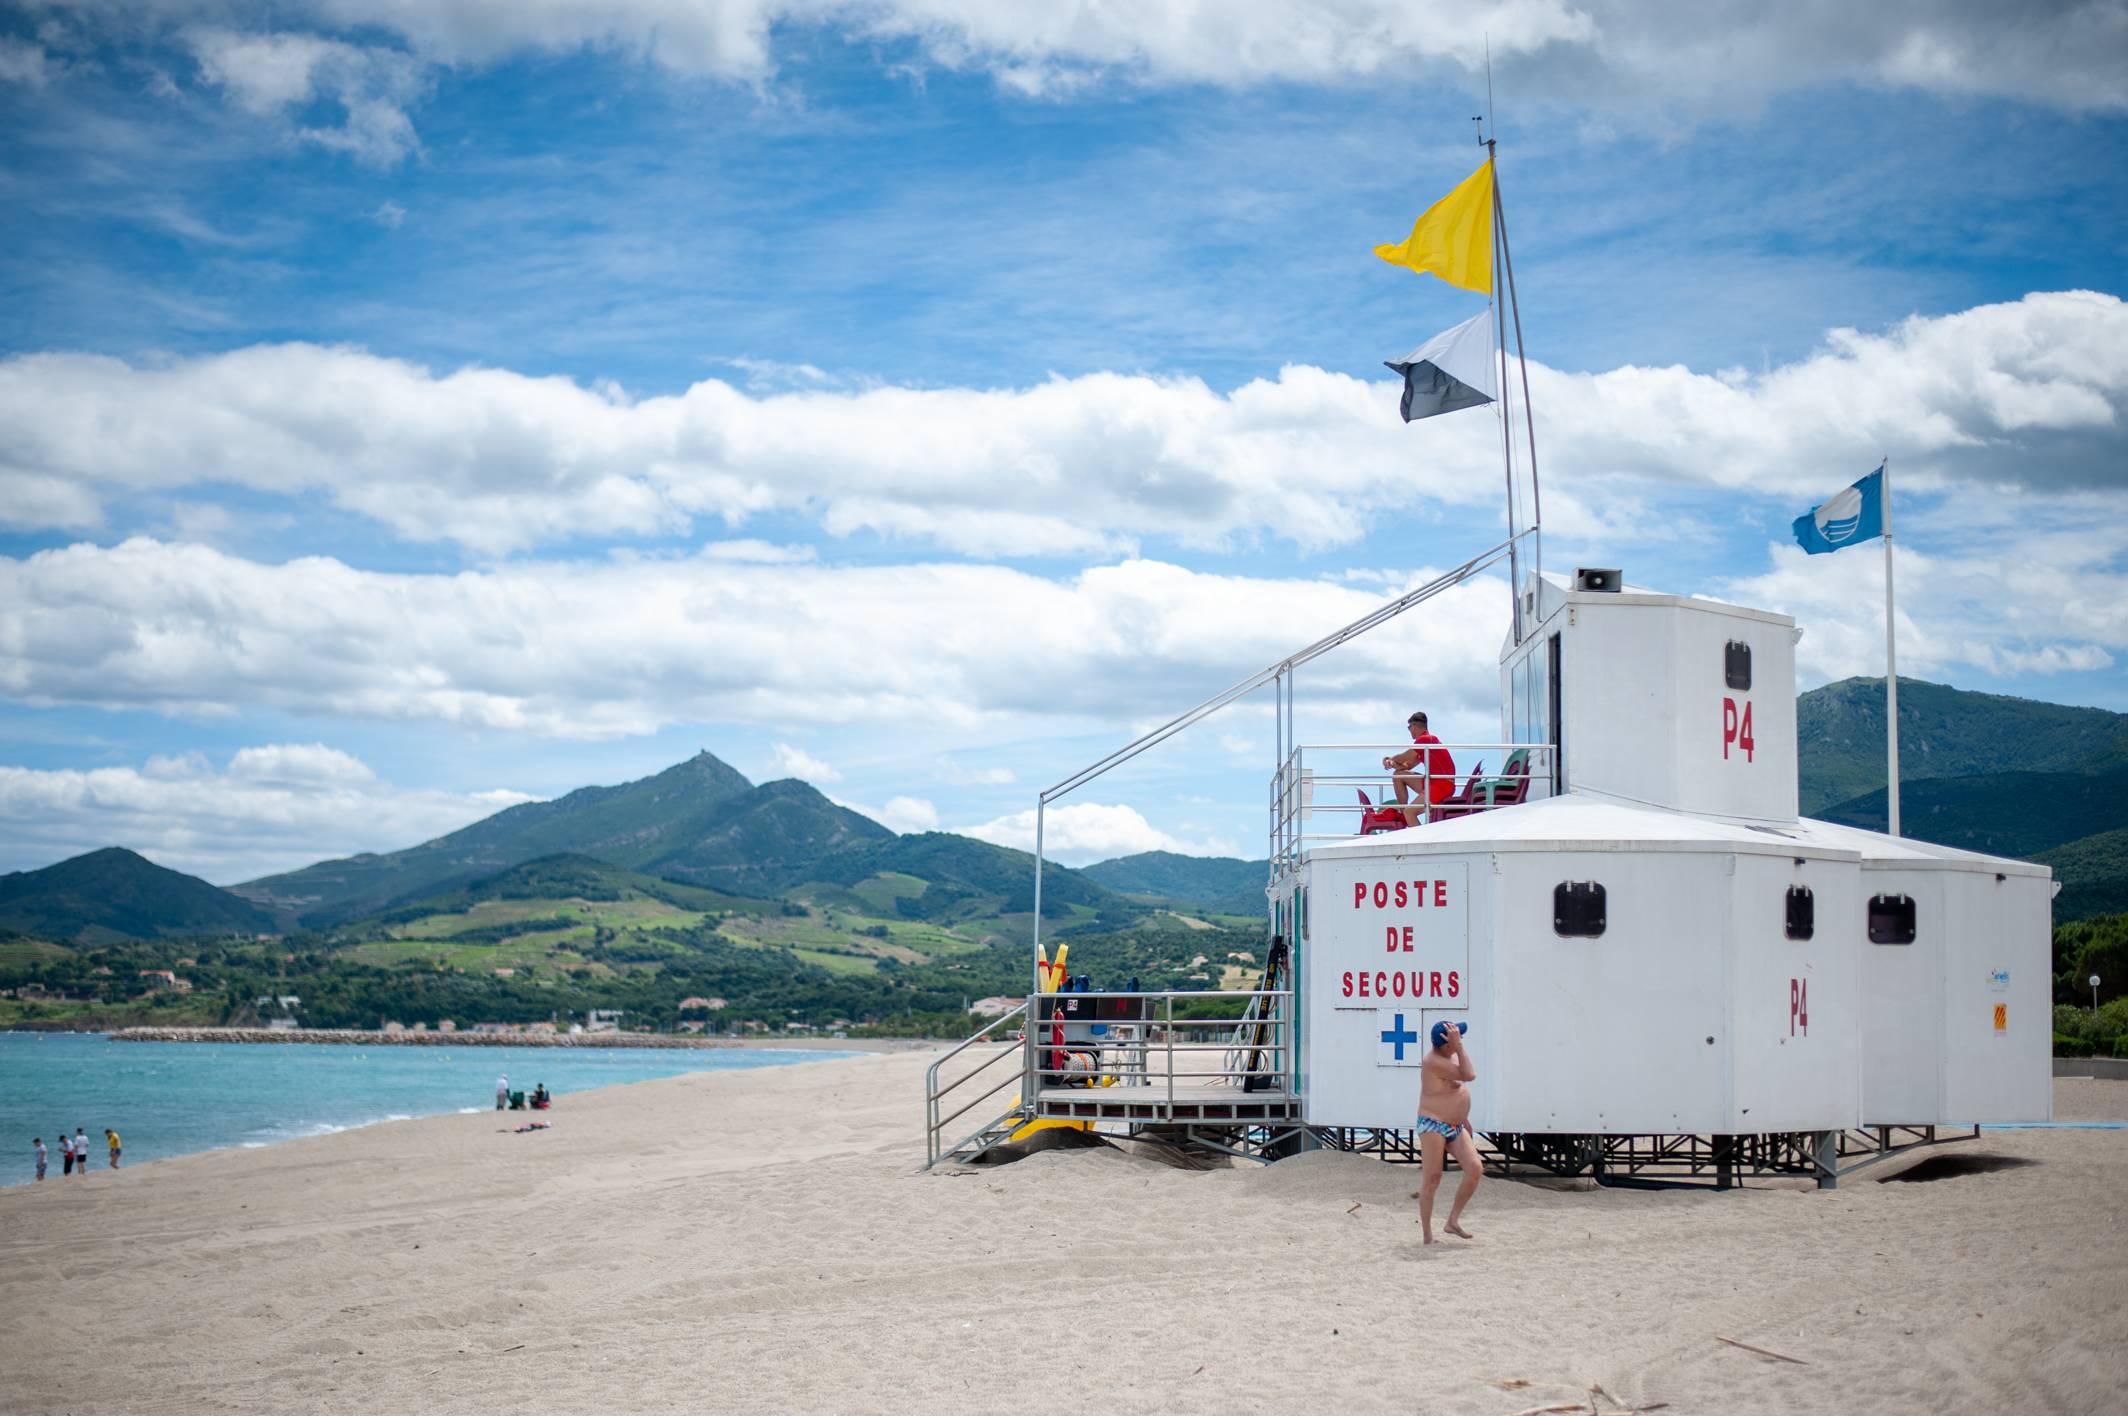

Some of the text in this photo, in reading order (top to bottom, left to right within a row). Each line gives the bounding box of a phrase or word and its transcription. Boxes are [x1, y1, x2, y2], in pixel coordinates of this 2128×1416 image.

[1723, 697, 1754, 763] P4
[1354, 880, 1448, 909] POSTE
[1386, 927, 1415, 952] DE
[1342, 971, 1460, 998] SECOURS
[1068, 1001, 1078, 1009] P4
[1791, 978, 1808, 1037] P4
